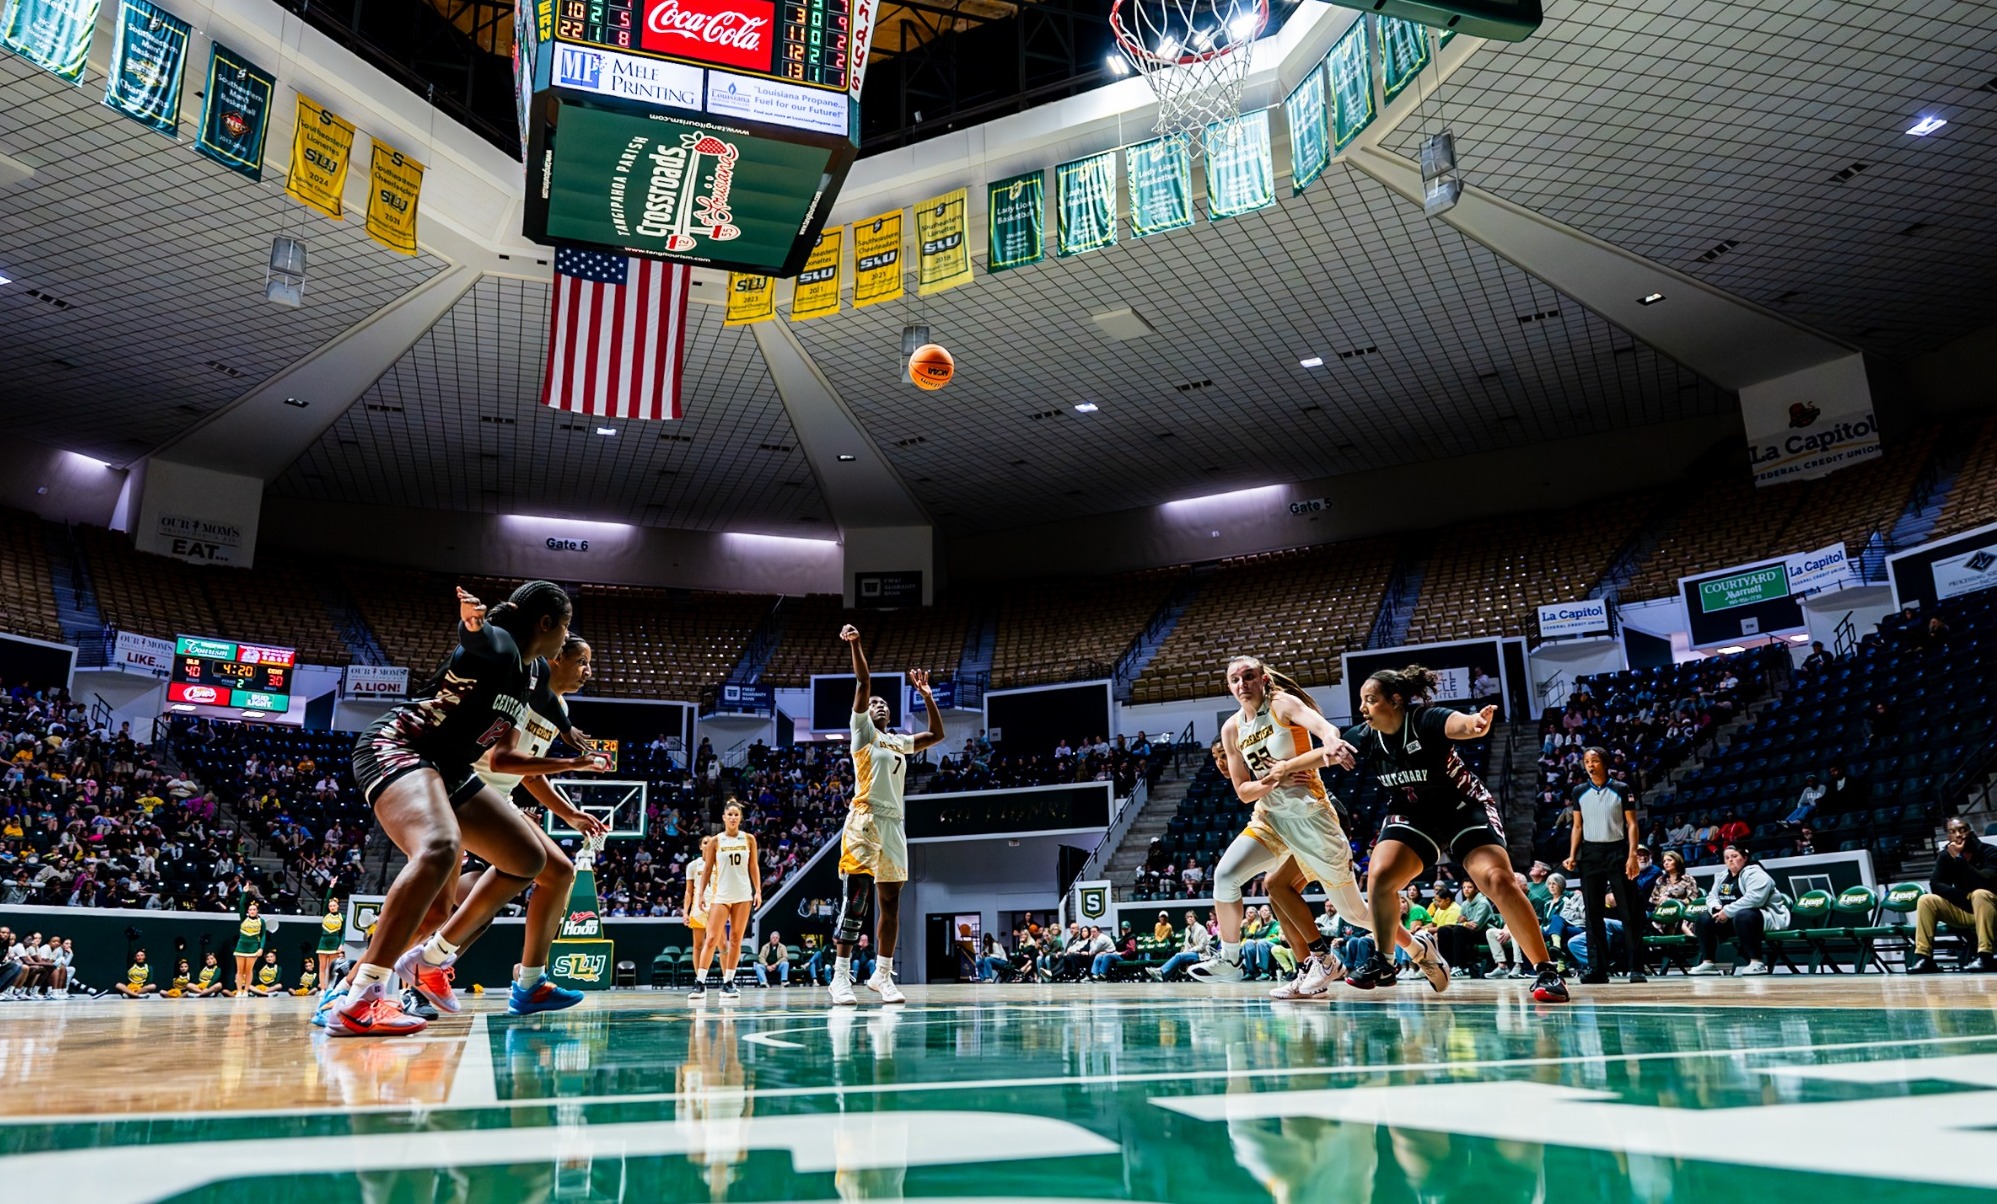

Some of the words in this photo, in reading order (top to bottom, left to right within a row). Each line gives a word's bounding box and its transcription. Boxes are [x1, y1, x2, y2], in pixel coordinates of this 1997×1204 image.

[538, 1, 552, 42] ERN
[568, 1, 584, 18] 10
[591, 6, 602, 22] 2
[621, 11, 630, 27] 5
[796, 7, 806, 25] 3
[812, 11, 822, 26] 0
[838, 16, 847, 31] 9
[560, 20, 583, 38] 22
[595, 27, 600, 41] 1
[619, 30, 629, 46] 8
[648, 0, 768, 51] Coca-Cola
[790, 25, 805, 42] 11
[811, 30, 821, 45] 0
[837, 34, 847, 50] 2
[852, 0, 871, 91] ndy's
[789, 44, 804, 60] 12
[810, 48, 820, 63] 2
[836, 53, 846, 68] 2
[561, 50, 602, 83] MP
[788, 62, 803, 80] 13
[814, 67, 819, 82] 1
[841, 72, 845, 87] 1
[217, 73, 263, 103] Southeastern
[612, 75, 695, 105] PRINTING
[221, 92, 256, 116] Basketball
[754, 96, 773, 106] Fuel
[776, 99, 789, 108] for
[791, 103, 807, 112] our
[809, 105, 844, 119] Future!"
[319, 109, 334, 127] S
[649, 113, 750, 136] www.tangitourism.com
[300, 118, 350, 151] Southeastern
[306, 132, 340, 157] Lionettes
[304, 147, 338, 174] SLU
[391, 151, 404, 168] S
[615, 136, 649, 173] PARISH
[309, 171, 329, 187] 2024
[375, 162, 418, 190] Southeastern
[1138, 168, 1157, 178] Lady
[380, 189, 408, 213] SLU
[636, 145, 687, 237] Crossroads
[610, 176, 631, 236] TANGIPAHOA
[997, 205, 1015, 216] Lady
[921, 214, 962, 232] Southeastern
[997, 210, 1035, 225] Basketball
[857, 231, 899, 247] Southeastern
[858, 239, 898, 254] Cheerleaders
[923, 233, 960, 254] SLU
[624, 246, 711, 263] www.tangitourism.com
[805, 257, 832, 267] onettes
[810, 247, 838, 258] heastern
[860, 250, 896, 270] SLU
[735, 276, 768, 292] SLU
[800, 267, 835, 283] SLU
[1748, 445, 1780, 465] La
[1785, 414, 1878, 454] Capitol
[1752, 466, 1801, 485] FEDERAL
[1804, 453, 1844, 469] CREDIT
[1847, 442, 1884, 458] UNION
[1290, 501, 1320, 514] Gate
[1324, 497, 1333, 509] 5
[161, 517, 189, 529] OUR
[203, 523, 240, 537] MOM'S
[172, 539, 228, 561] EAT...
[545, 537, 577, 551] Gate
[580, 540, 589, 551] 6
[1788, 566, 1804, 577] La
[1804, 550, 1844, 571] Capitol
[1704, 571, 1777, 594] COURTYARD
[1542, 612, 1557, 622] La
[1559, 605, 1604, 620] Capitol
[120, 635, 140, 645] OUR
[148, 640, 173, 652] MOM'S
[184, 638, 228, 657] Tourism
[127, 652, 166, 669] LIKE...
[223, 664, 254, 677] 4:20
[184, 666, 201, 678] 40
[268, 675, 284, 687] 30
[267, 667, 284, 675] CENT
[351, 667, 371, 675] OUR
[236, 679, 245, 689] 2
[353, 682, 363, 691] A
[365, 682, 401, 692] LION!
[1437, 681, 1458, 693] CLE
[247, 699, 273, 708] LIGHT
[251, 693, 270, 701] BUD
[475, 716, 512, 748] 12
[590, 740, 617, 751] 4:20
[892, 755, 902, 775] 7
[729, 853, 741, 866] 10
[1086, 894, 1100, 911] S
[1657, 906, 1678, 916] Lions
[1797, 897, 1825, 908] Lions
[1838, 893, 1868, 905] Lions
[1887, 890, 1919, 902] Lions
[552, 953, 607, 980] SLU
